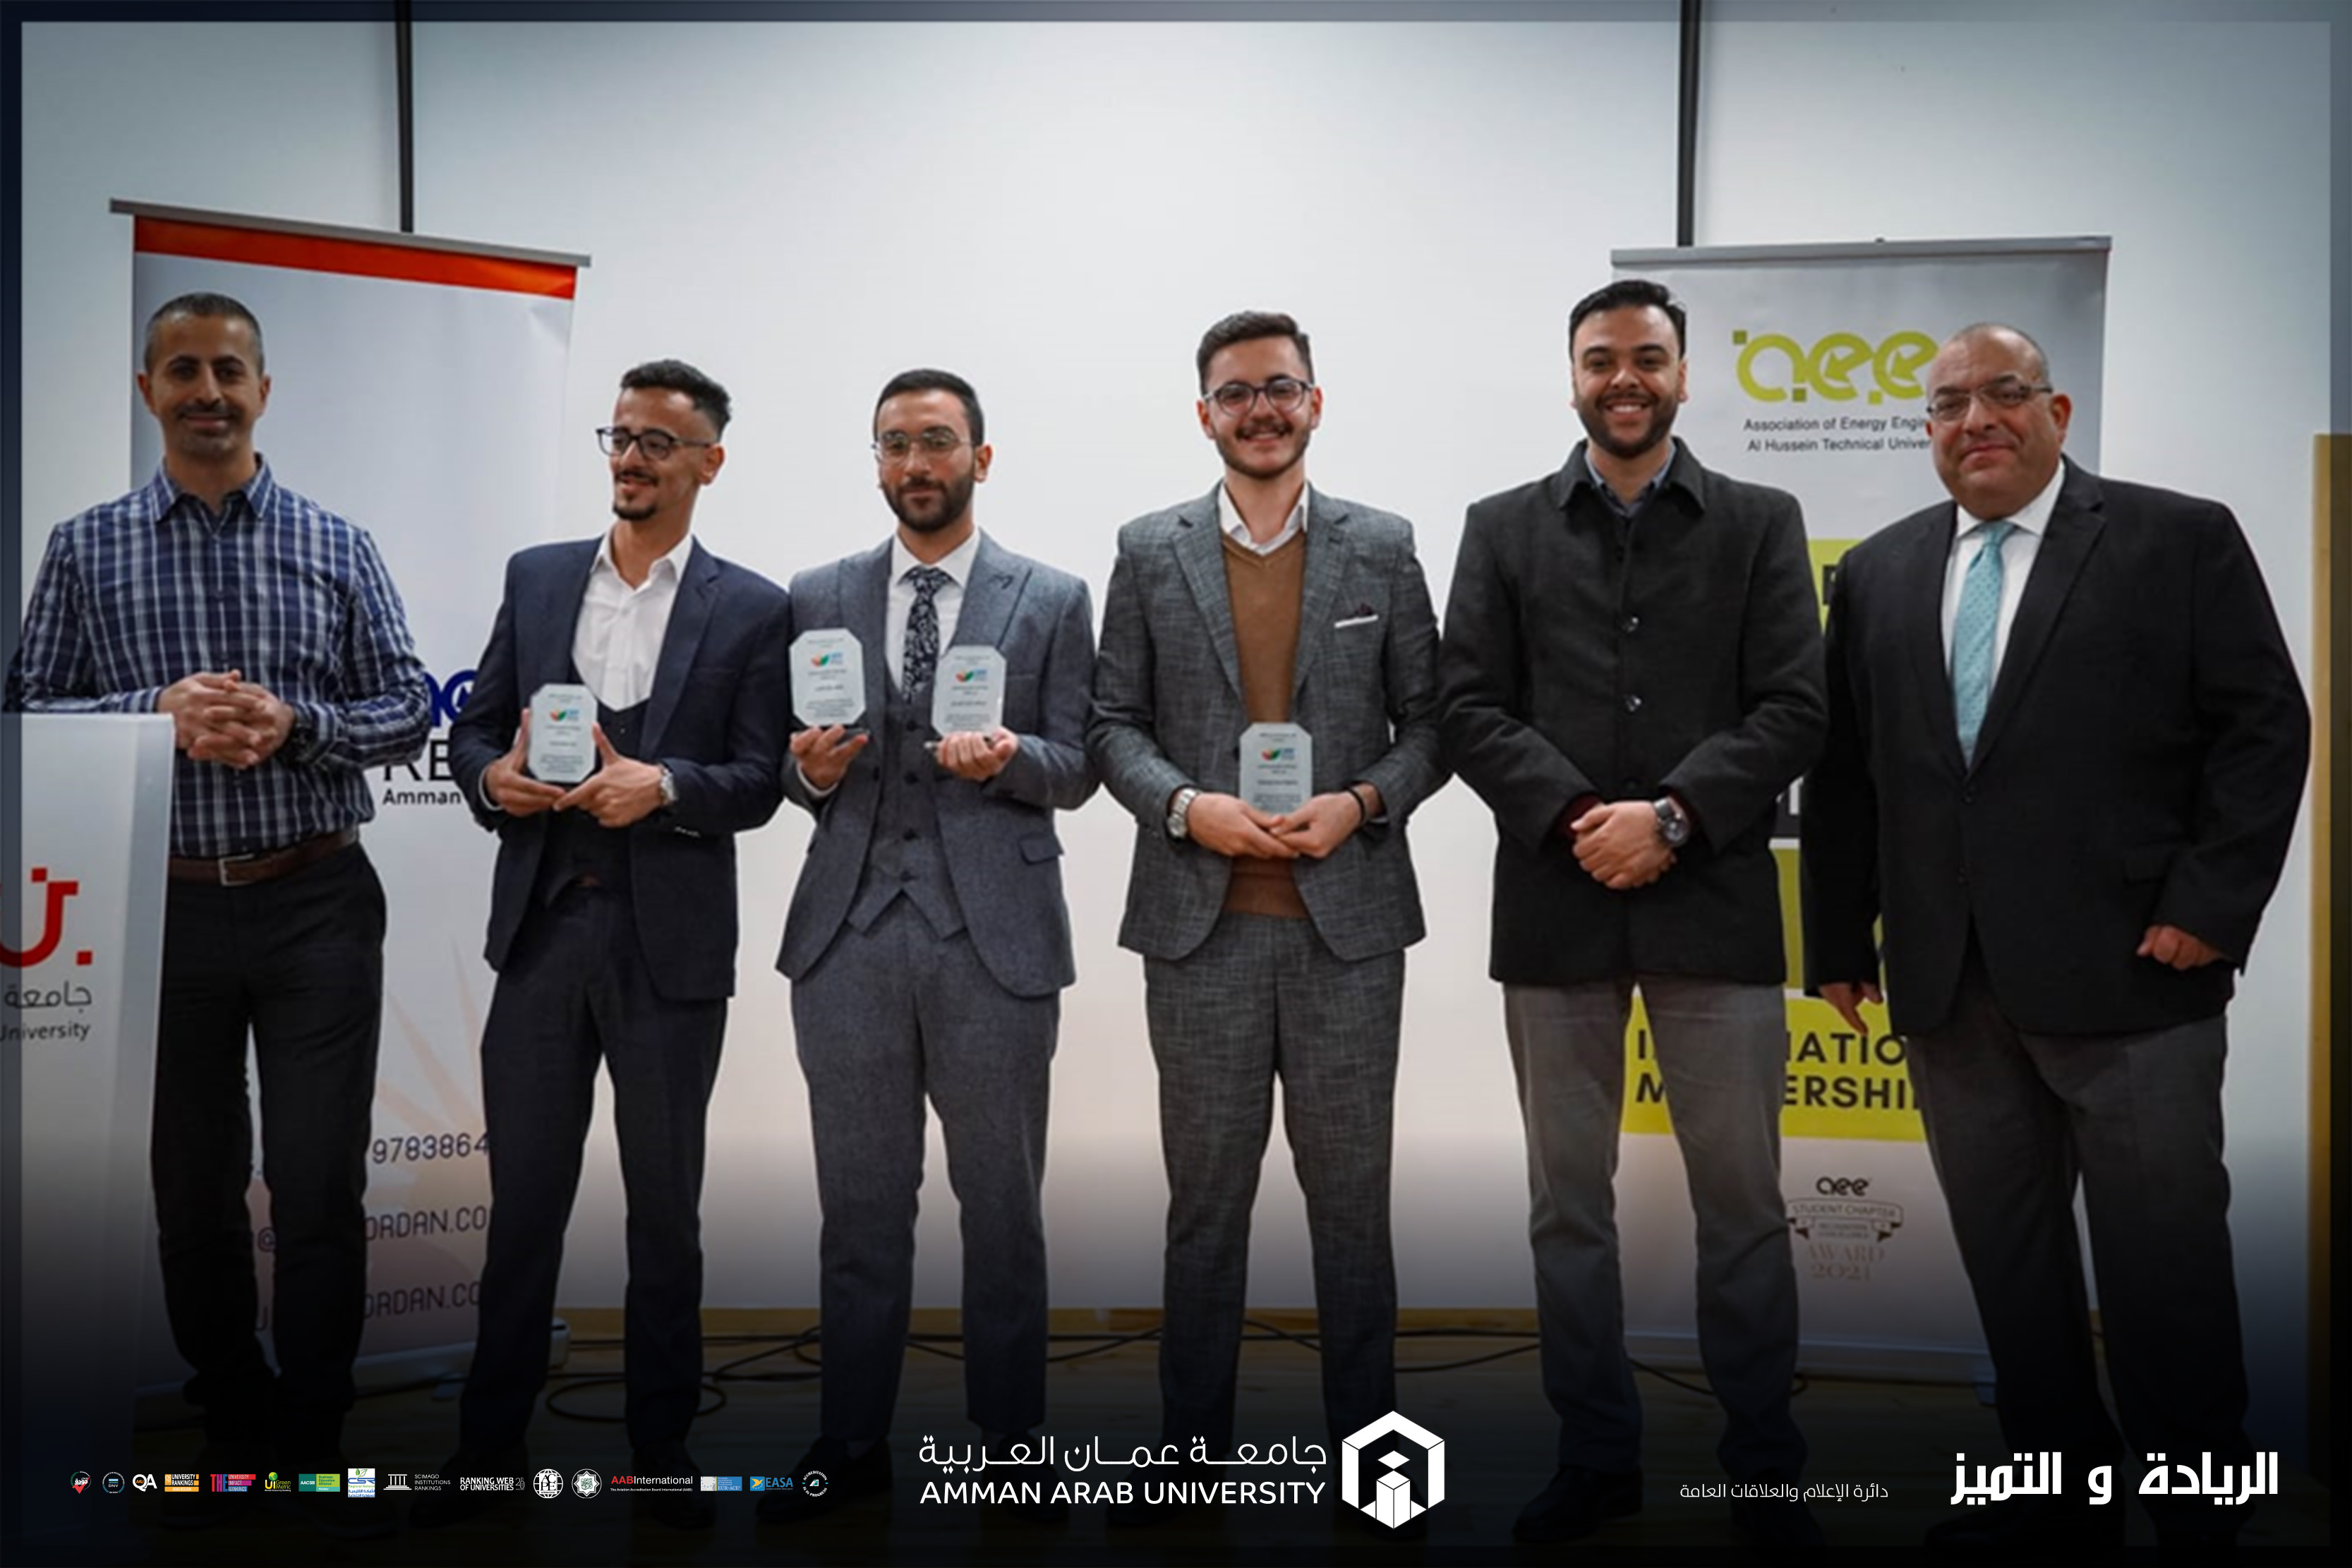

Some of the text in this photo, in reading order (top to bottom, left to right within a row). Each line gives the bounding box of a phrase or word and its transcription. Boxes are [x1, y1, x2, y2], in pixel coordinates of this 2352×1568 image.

[1744, 418, 1820, 431] Association
[1823, 417, 1837, 430] of
[1840, 417, 1887, 432] Energy
[1748, 440, 1761, 452] Al
[1765, 439, 1818, 452] Hussein
[1822, 438, 1884, 451] Technical
[383, 788, 461, 805] Amman
[4, 980, 92, 1014] جامعة
[1845, 1205, 1897, 1217] CHAPTER
